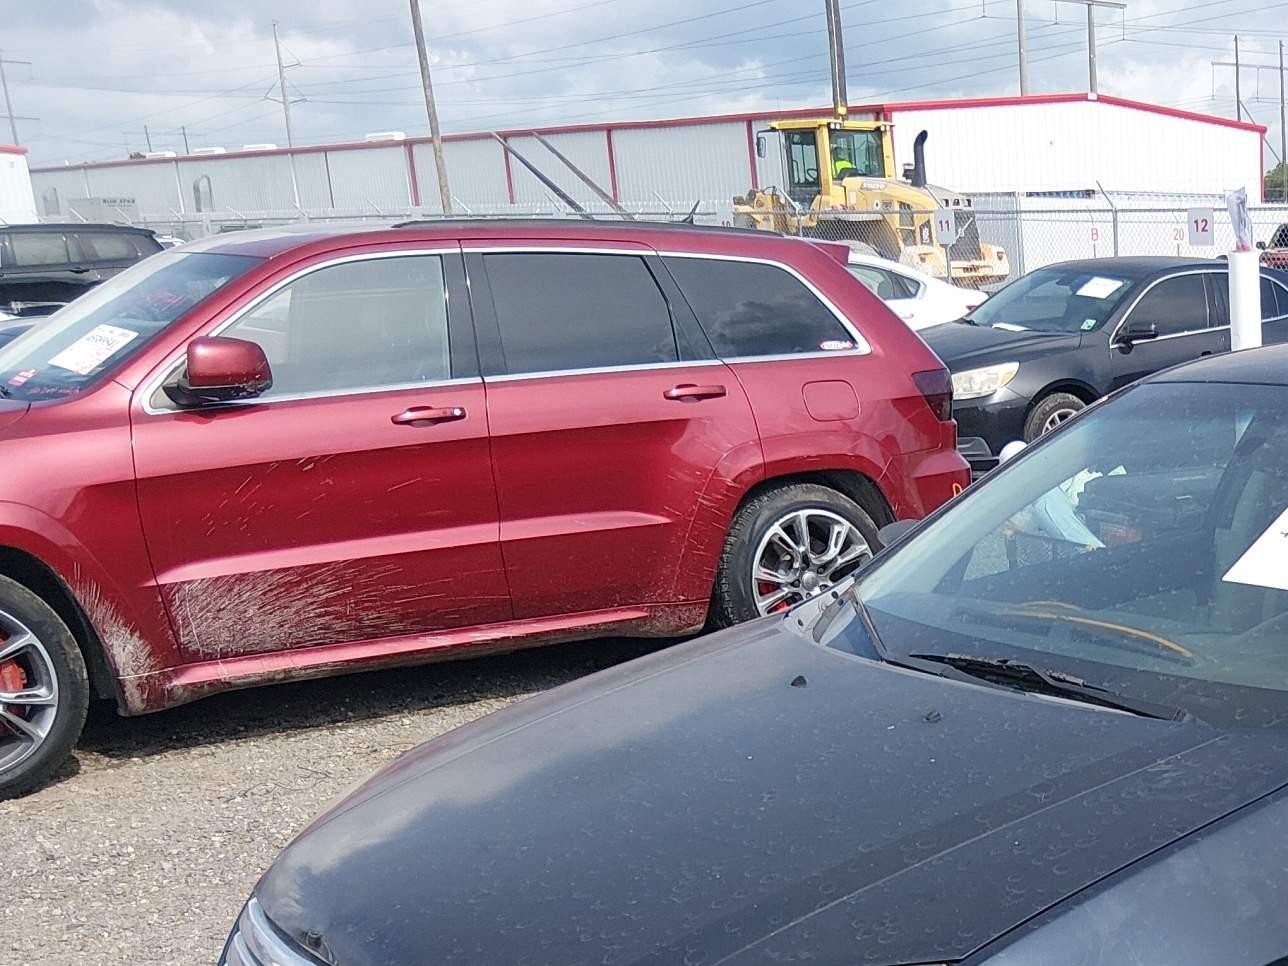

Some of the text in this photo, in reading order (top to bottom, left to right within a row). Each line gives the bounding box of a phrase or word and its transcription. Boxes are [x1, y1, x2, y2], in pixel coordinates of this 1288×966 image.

[938, 220, 950, 232] 11
[1193, 218, 1209, 233] 12
[1173, 227, 1185, 241] 20
